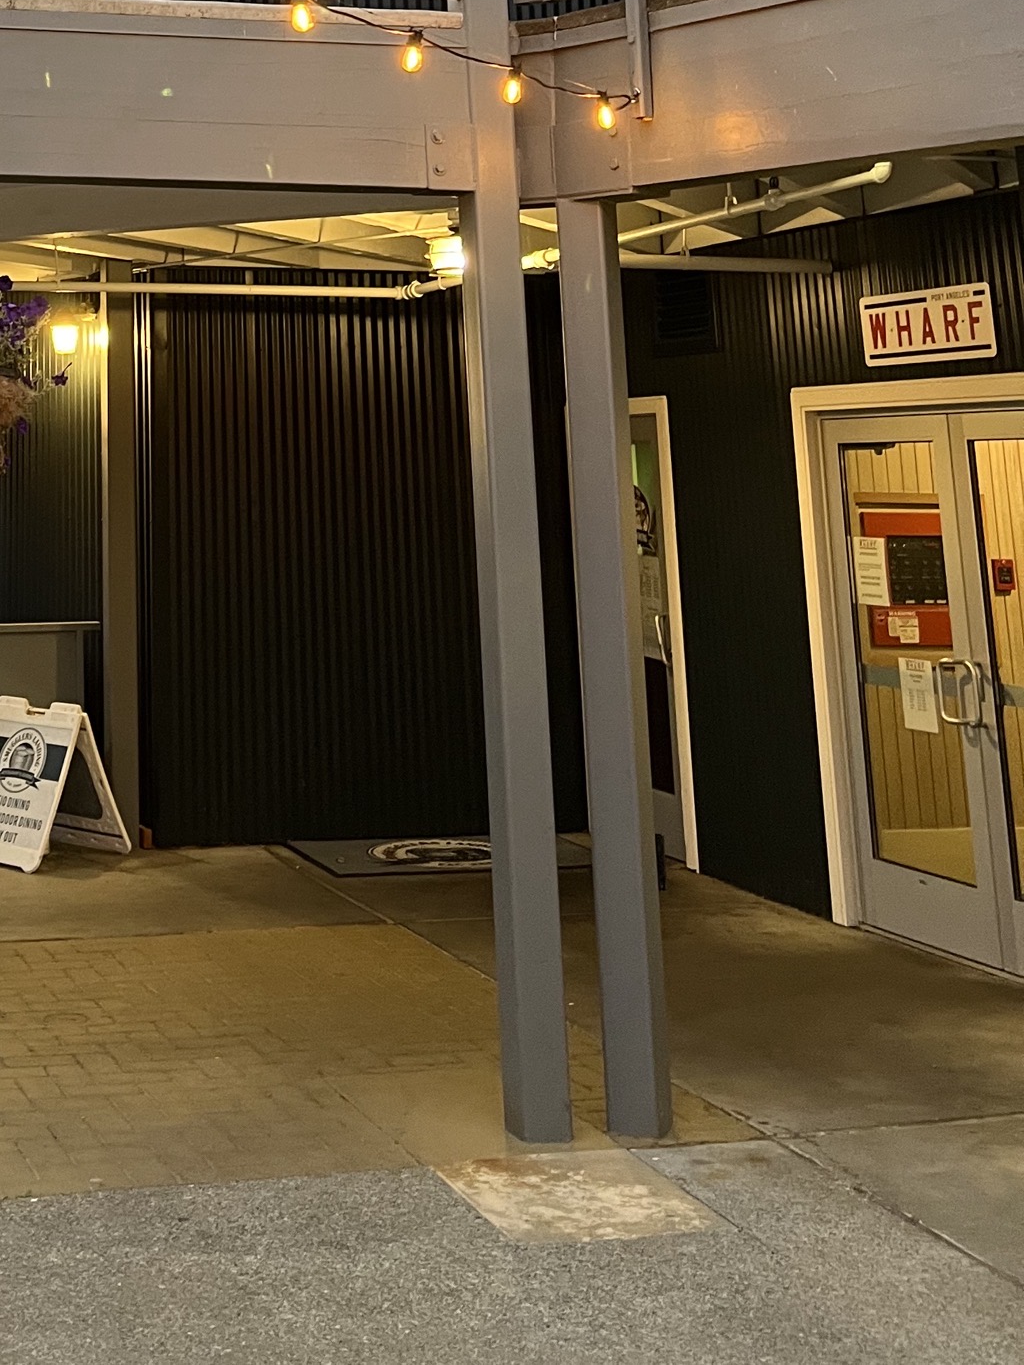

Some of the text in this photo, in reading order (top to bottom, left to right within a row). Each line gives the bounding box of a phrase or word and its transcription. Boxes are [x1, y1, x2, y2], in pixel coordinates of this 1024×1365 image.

[868, 300, 984, 350] WHARF
[6, 796, 31, 811] DINING
[17, 816, 43, 831] DINING
[3, 830, 18, 844] OUT
